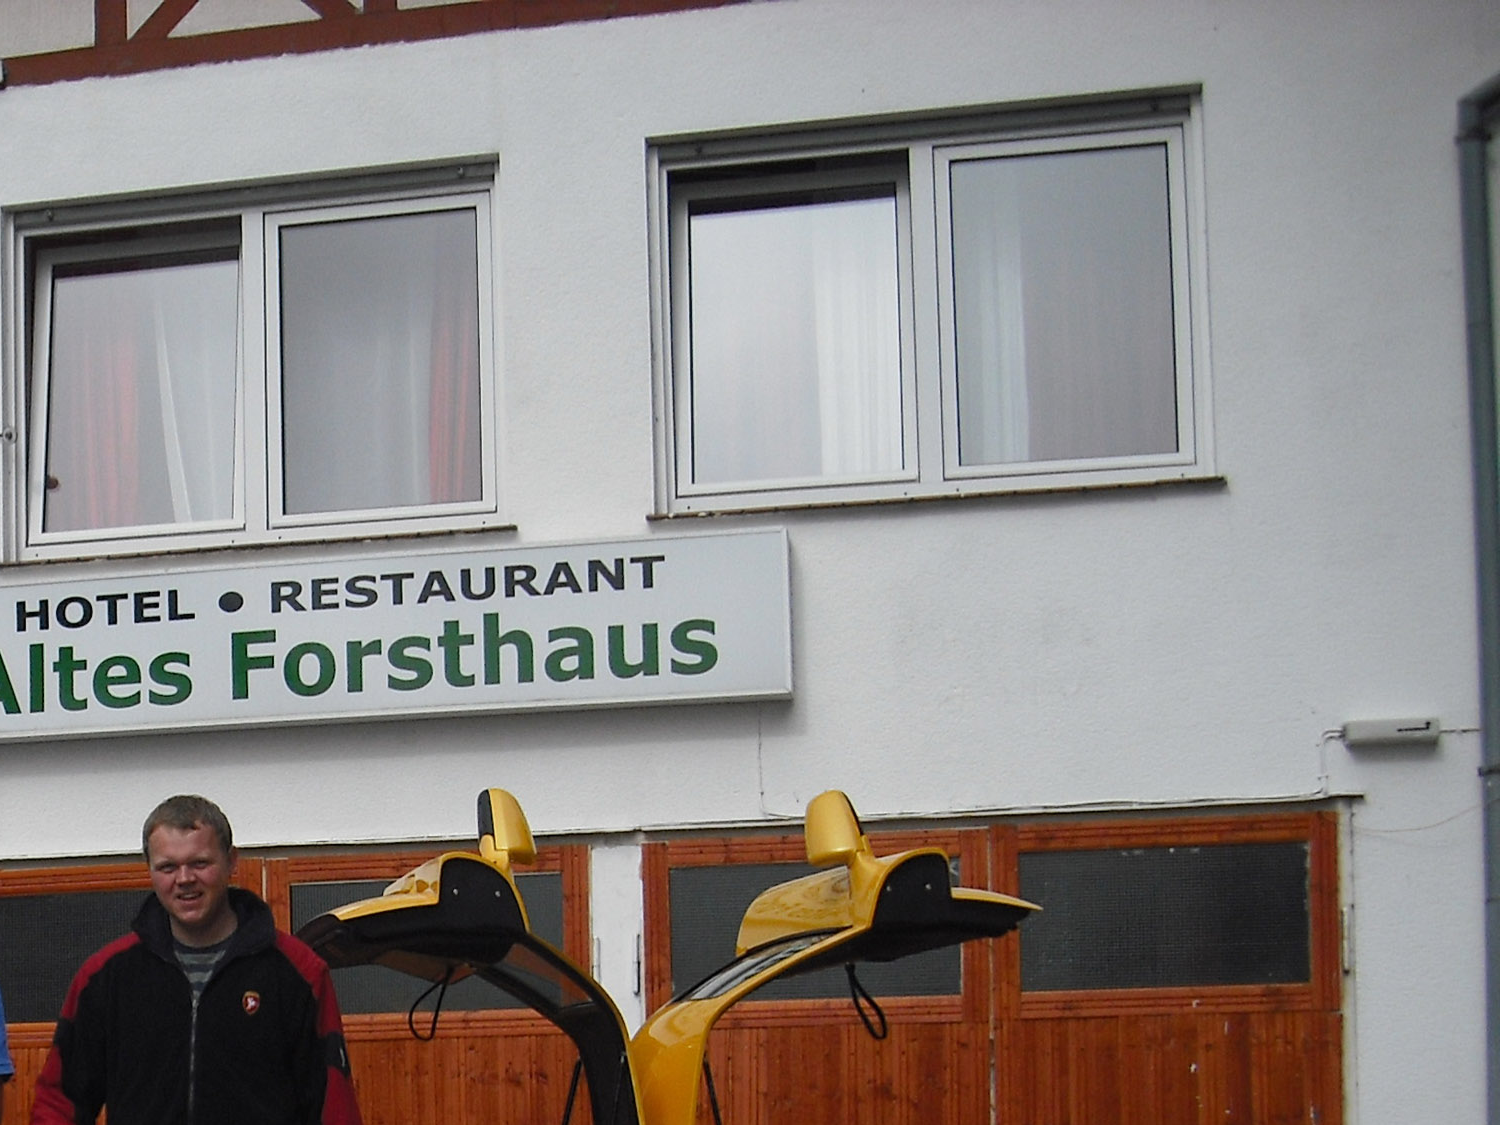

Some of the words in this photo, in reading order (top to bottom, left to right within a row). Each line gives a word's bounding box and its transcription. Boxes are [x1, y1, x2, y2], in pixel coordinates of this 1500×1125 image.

[16, 589, 196, 632] HOTEL
[270, 555, 666, 613] RESTAURANT
[232, 612, 719, 700] Forsthaus
